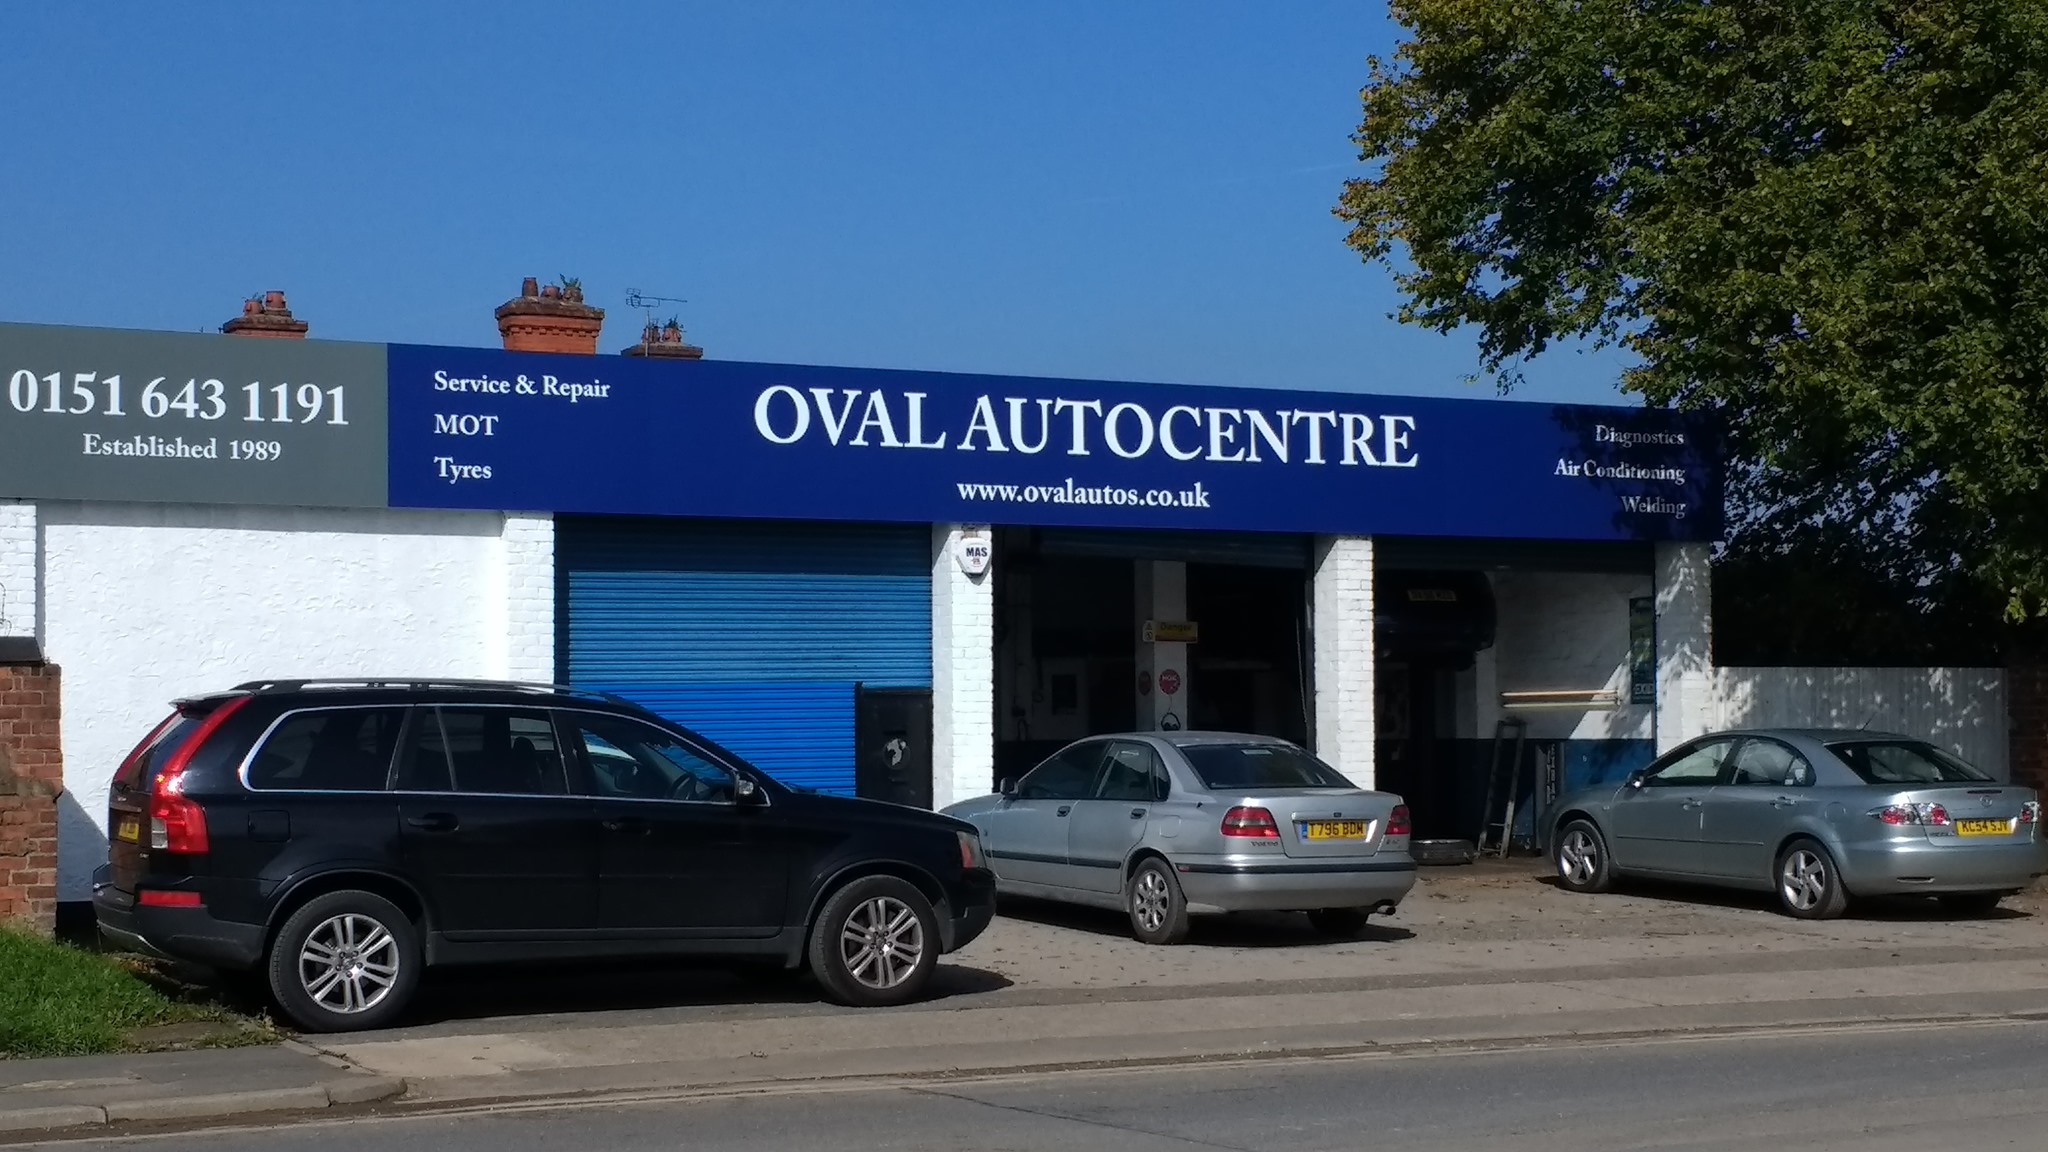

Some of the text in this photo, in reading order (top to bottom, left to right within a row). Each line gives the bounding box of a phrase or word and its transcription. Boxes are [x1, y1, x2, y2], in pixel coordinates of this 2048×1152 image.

[9, 369, 349, 426] 0151 643 1191
[433, 369, 611, 404] Service & Repair
[433, 413, 499, 436] MOT
[753, 384, 1418, 468] OVAL AUTOCENTRE
[1594, 424, 1685, 448] Diagnostics
[82, 432, 282, 462] Established 1989
[433, 455, 493, 485] Tyres
[1553, 457, 1686, 486] Air Conditioning
[956, 477, 1211, 510] www.ovalautos.co.uk
[1620, 495, 1687, 520] Welding
[966, 547, 988, 557] MAS
[1308, 822, 1340, 837] T796
[1961, 819, 1988, 832] KC54
